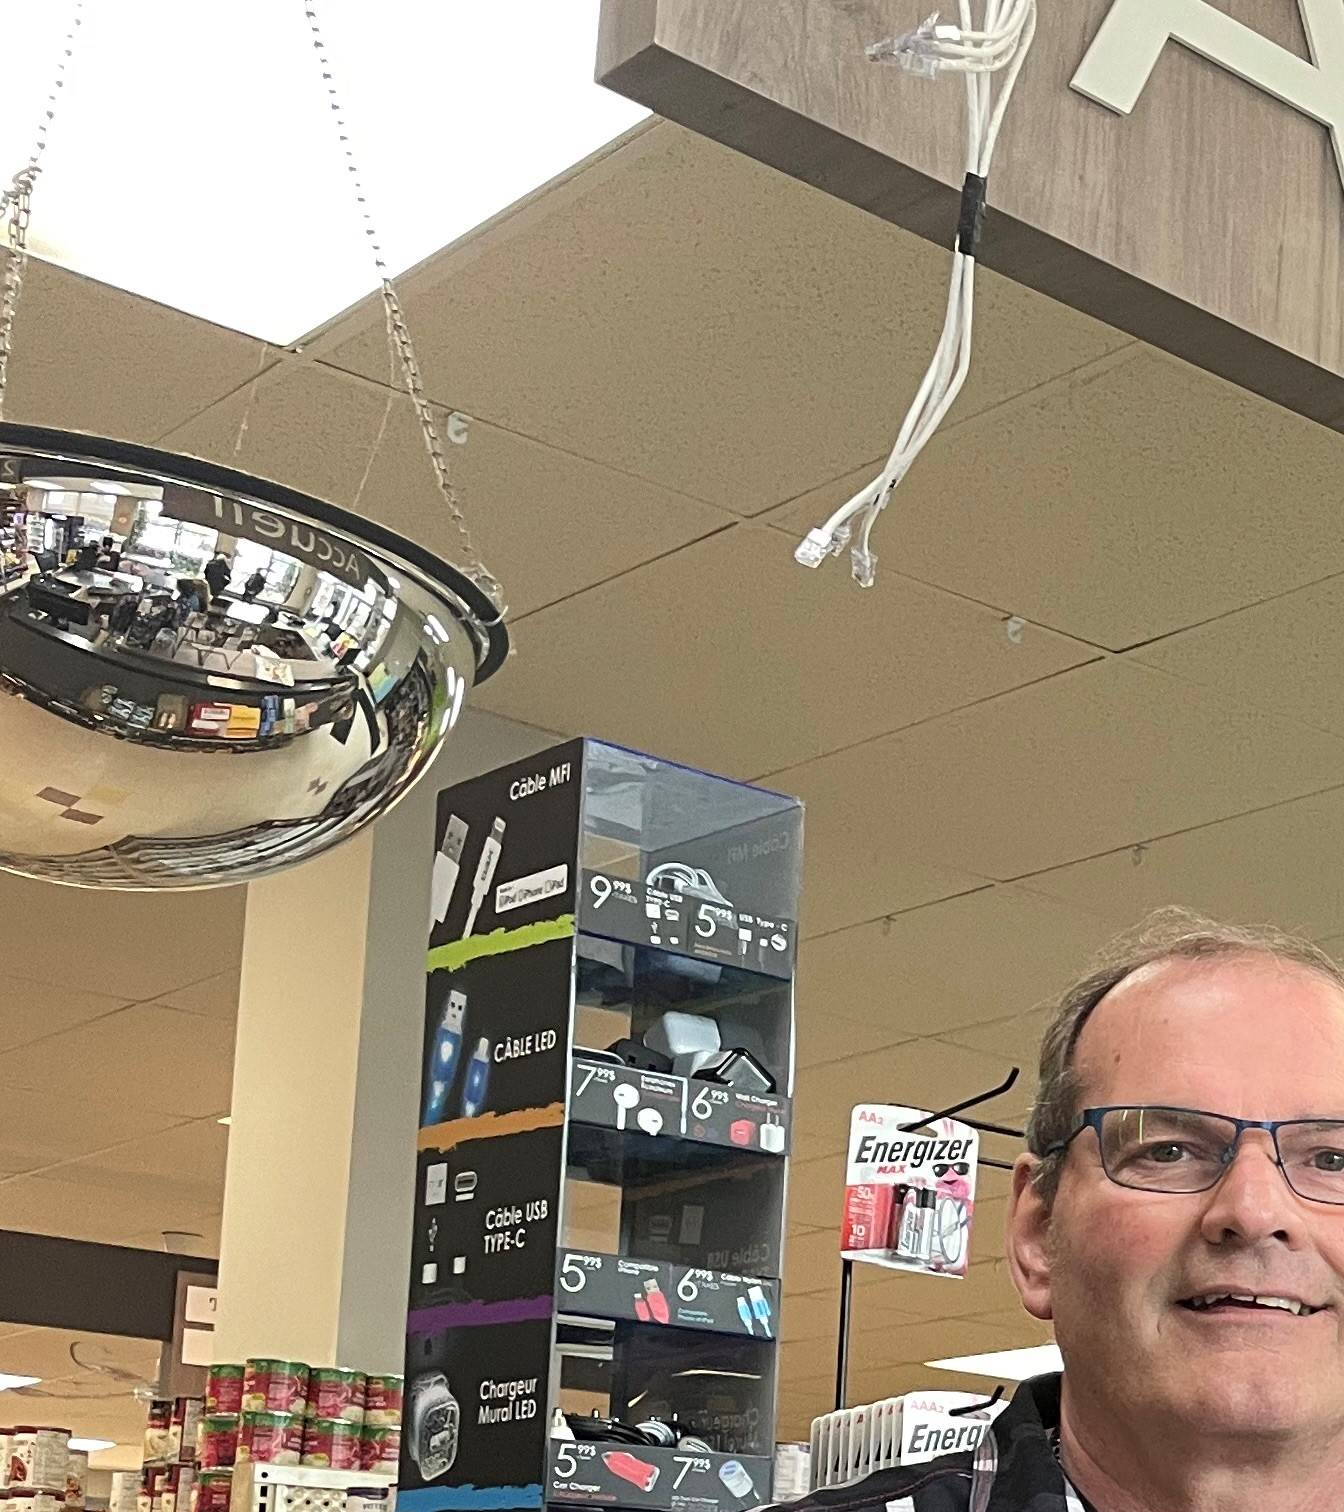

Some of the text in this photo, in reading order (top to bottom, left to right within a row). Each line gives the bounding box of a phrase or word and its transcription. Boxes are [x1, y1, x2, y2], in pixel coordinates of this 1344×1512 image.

[494, 1029, 557, 1063] CÂBLE LED
[854, 1135, 974, 1169] Energizer
[485, 1199, 548, 1230] Câble USB
[484, 1228, 526, 1254] TYPE-C
[479, 1378, 538, 1401] Chargeur
[477, 1399, 537, 1425] Mural LED
[907, 1423, 990, 1454] Energ
